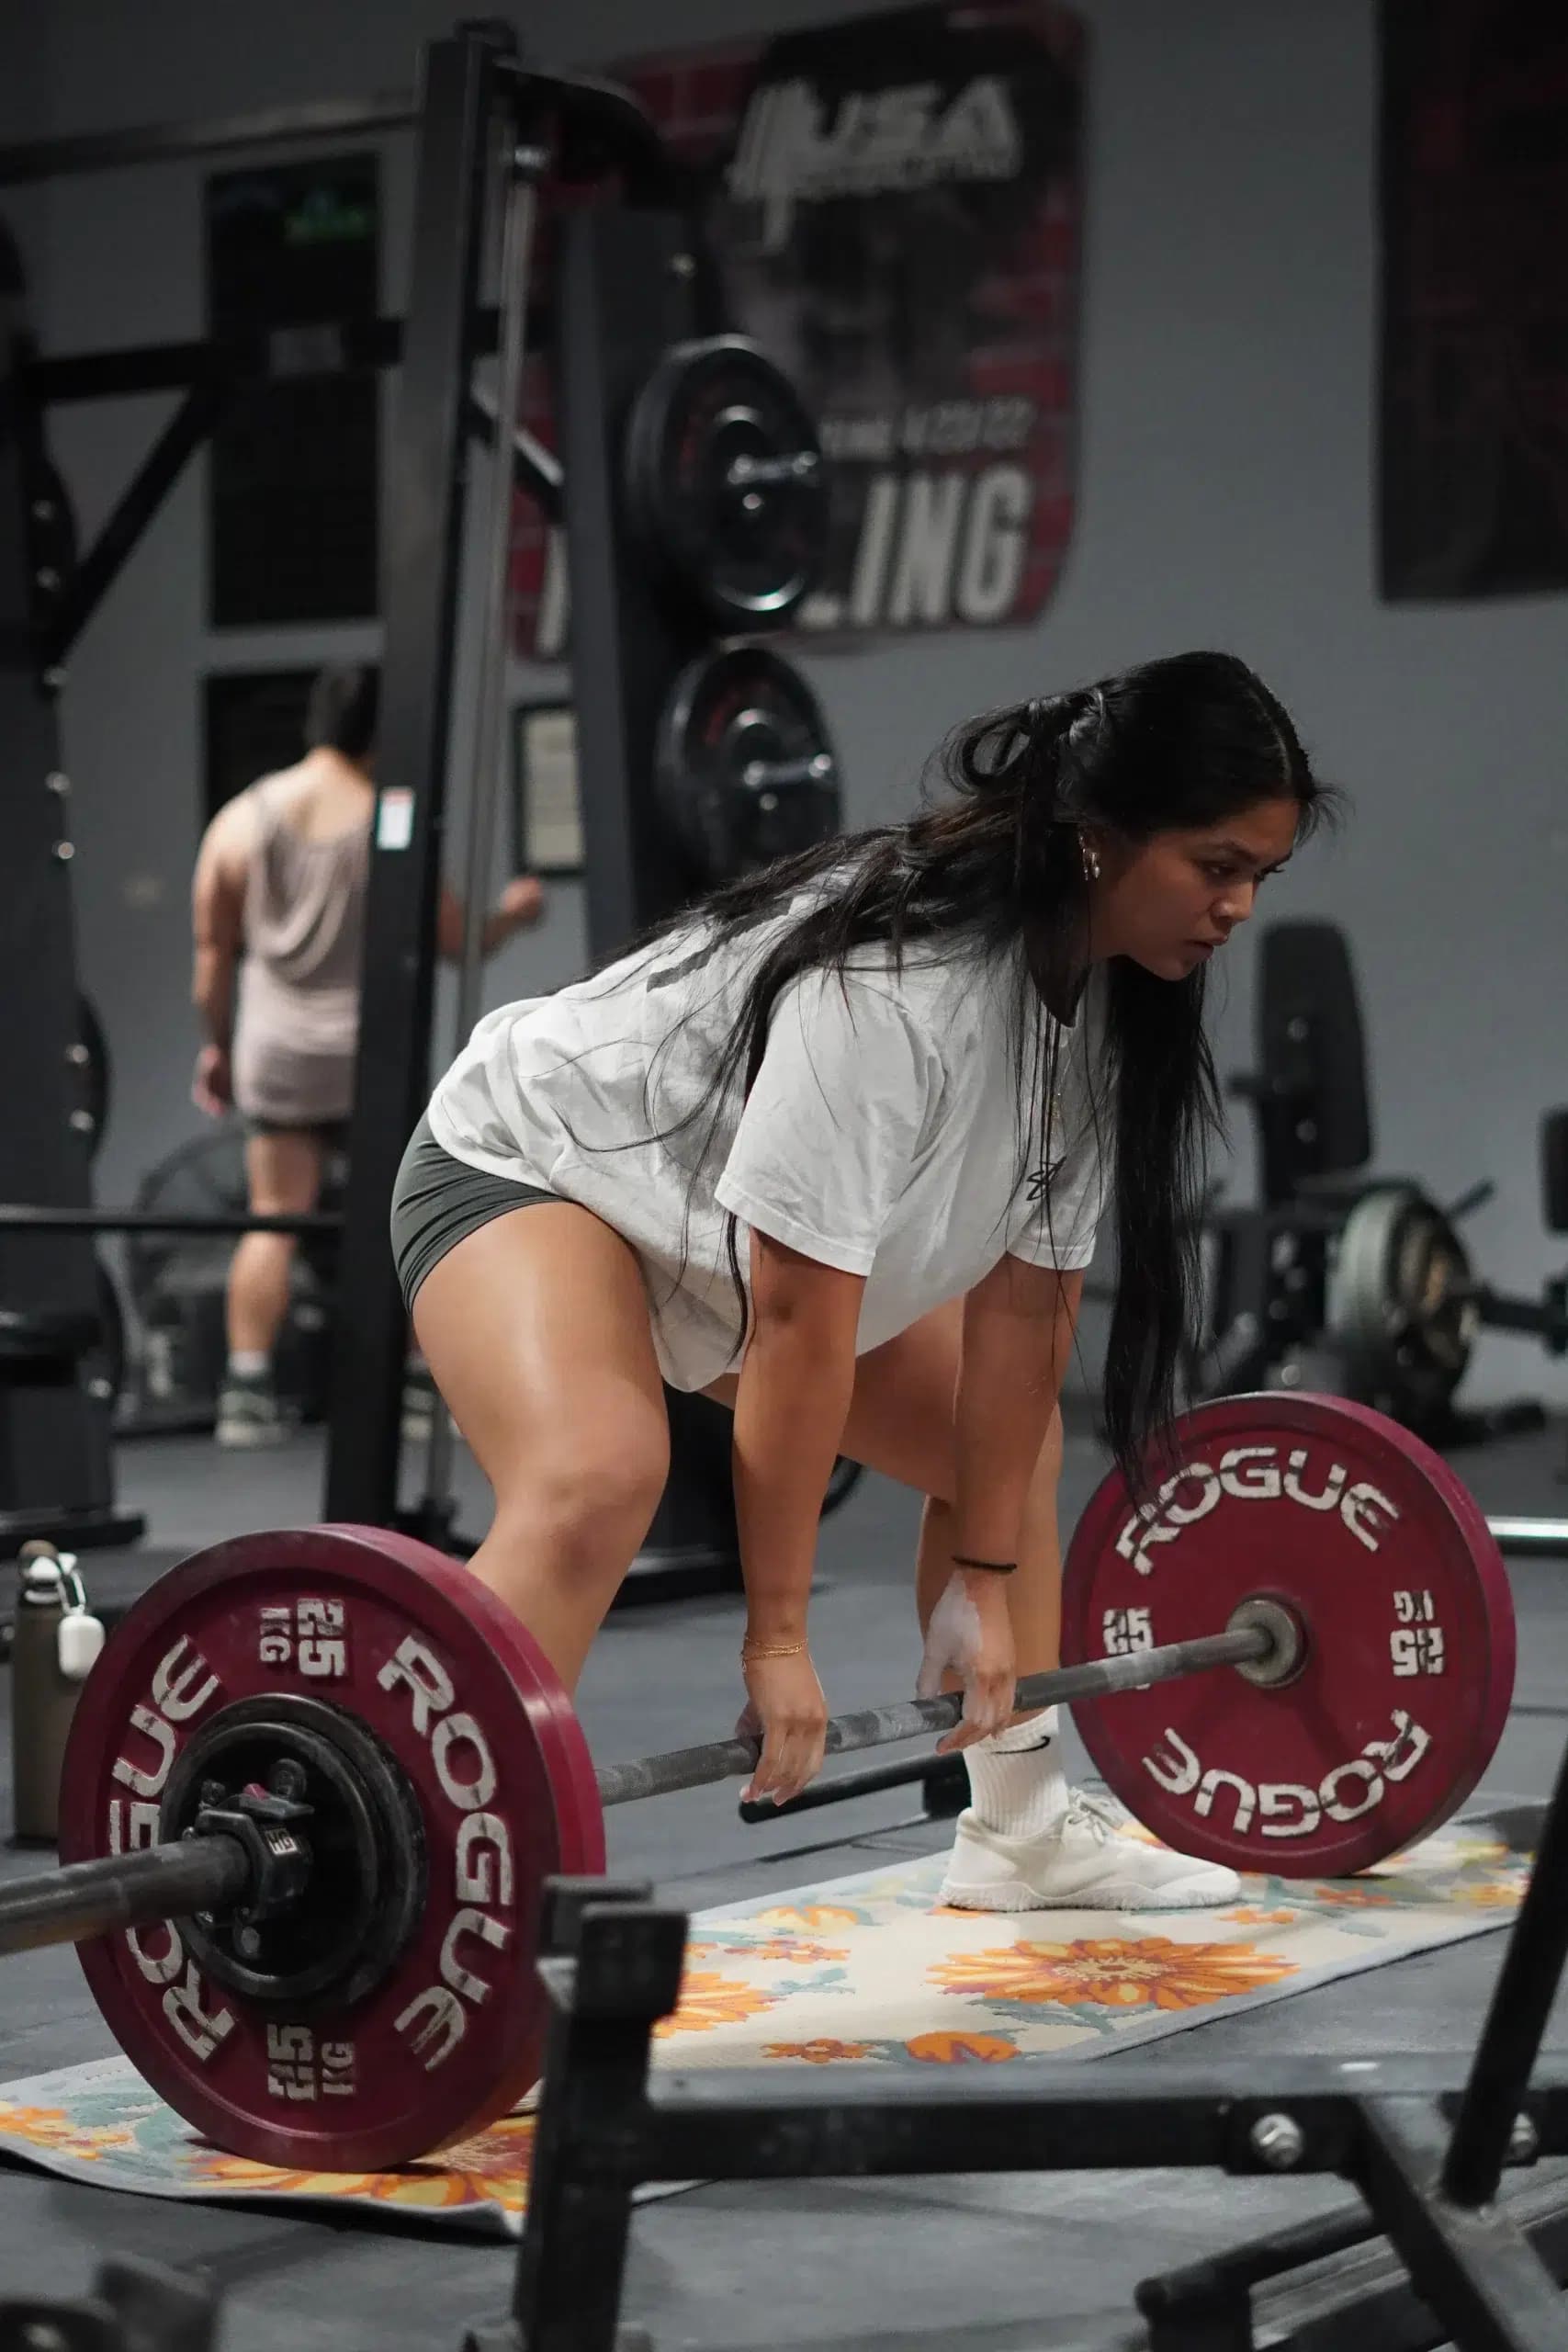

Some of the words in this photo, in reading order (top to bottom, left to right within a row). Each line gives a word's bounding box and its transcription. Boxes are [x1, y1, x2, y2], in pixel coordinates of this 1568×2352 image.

[1115, 1447, 1400, 1575] ROGUE
[260, 1608, 292, 1662] KG
[298, 1599, 345, 1676] 25
[1102, 1607, 1155, 1654] 25
[1390, 1627, 1444, 1676] 25
[1142, 1709, 1432, 1838] ROGUE
[377, 1635, 514, 2072] ROGUE
[267, 2024, 317, 2100] 25
[321, 2042, 355, 2095] KG
